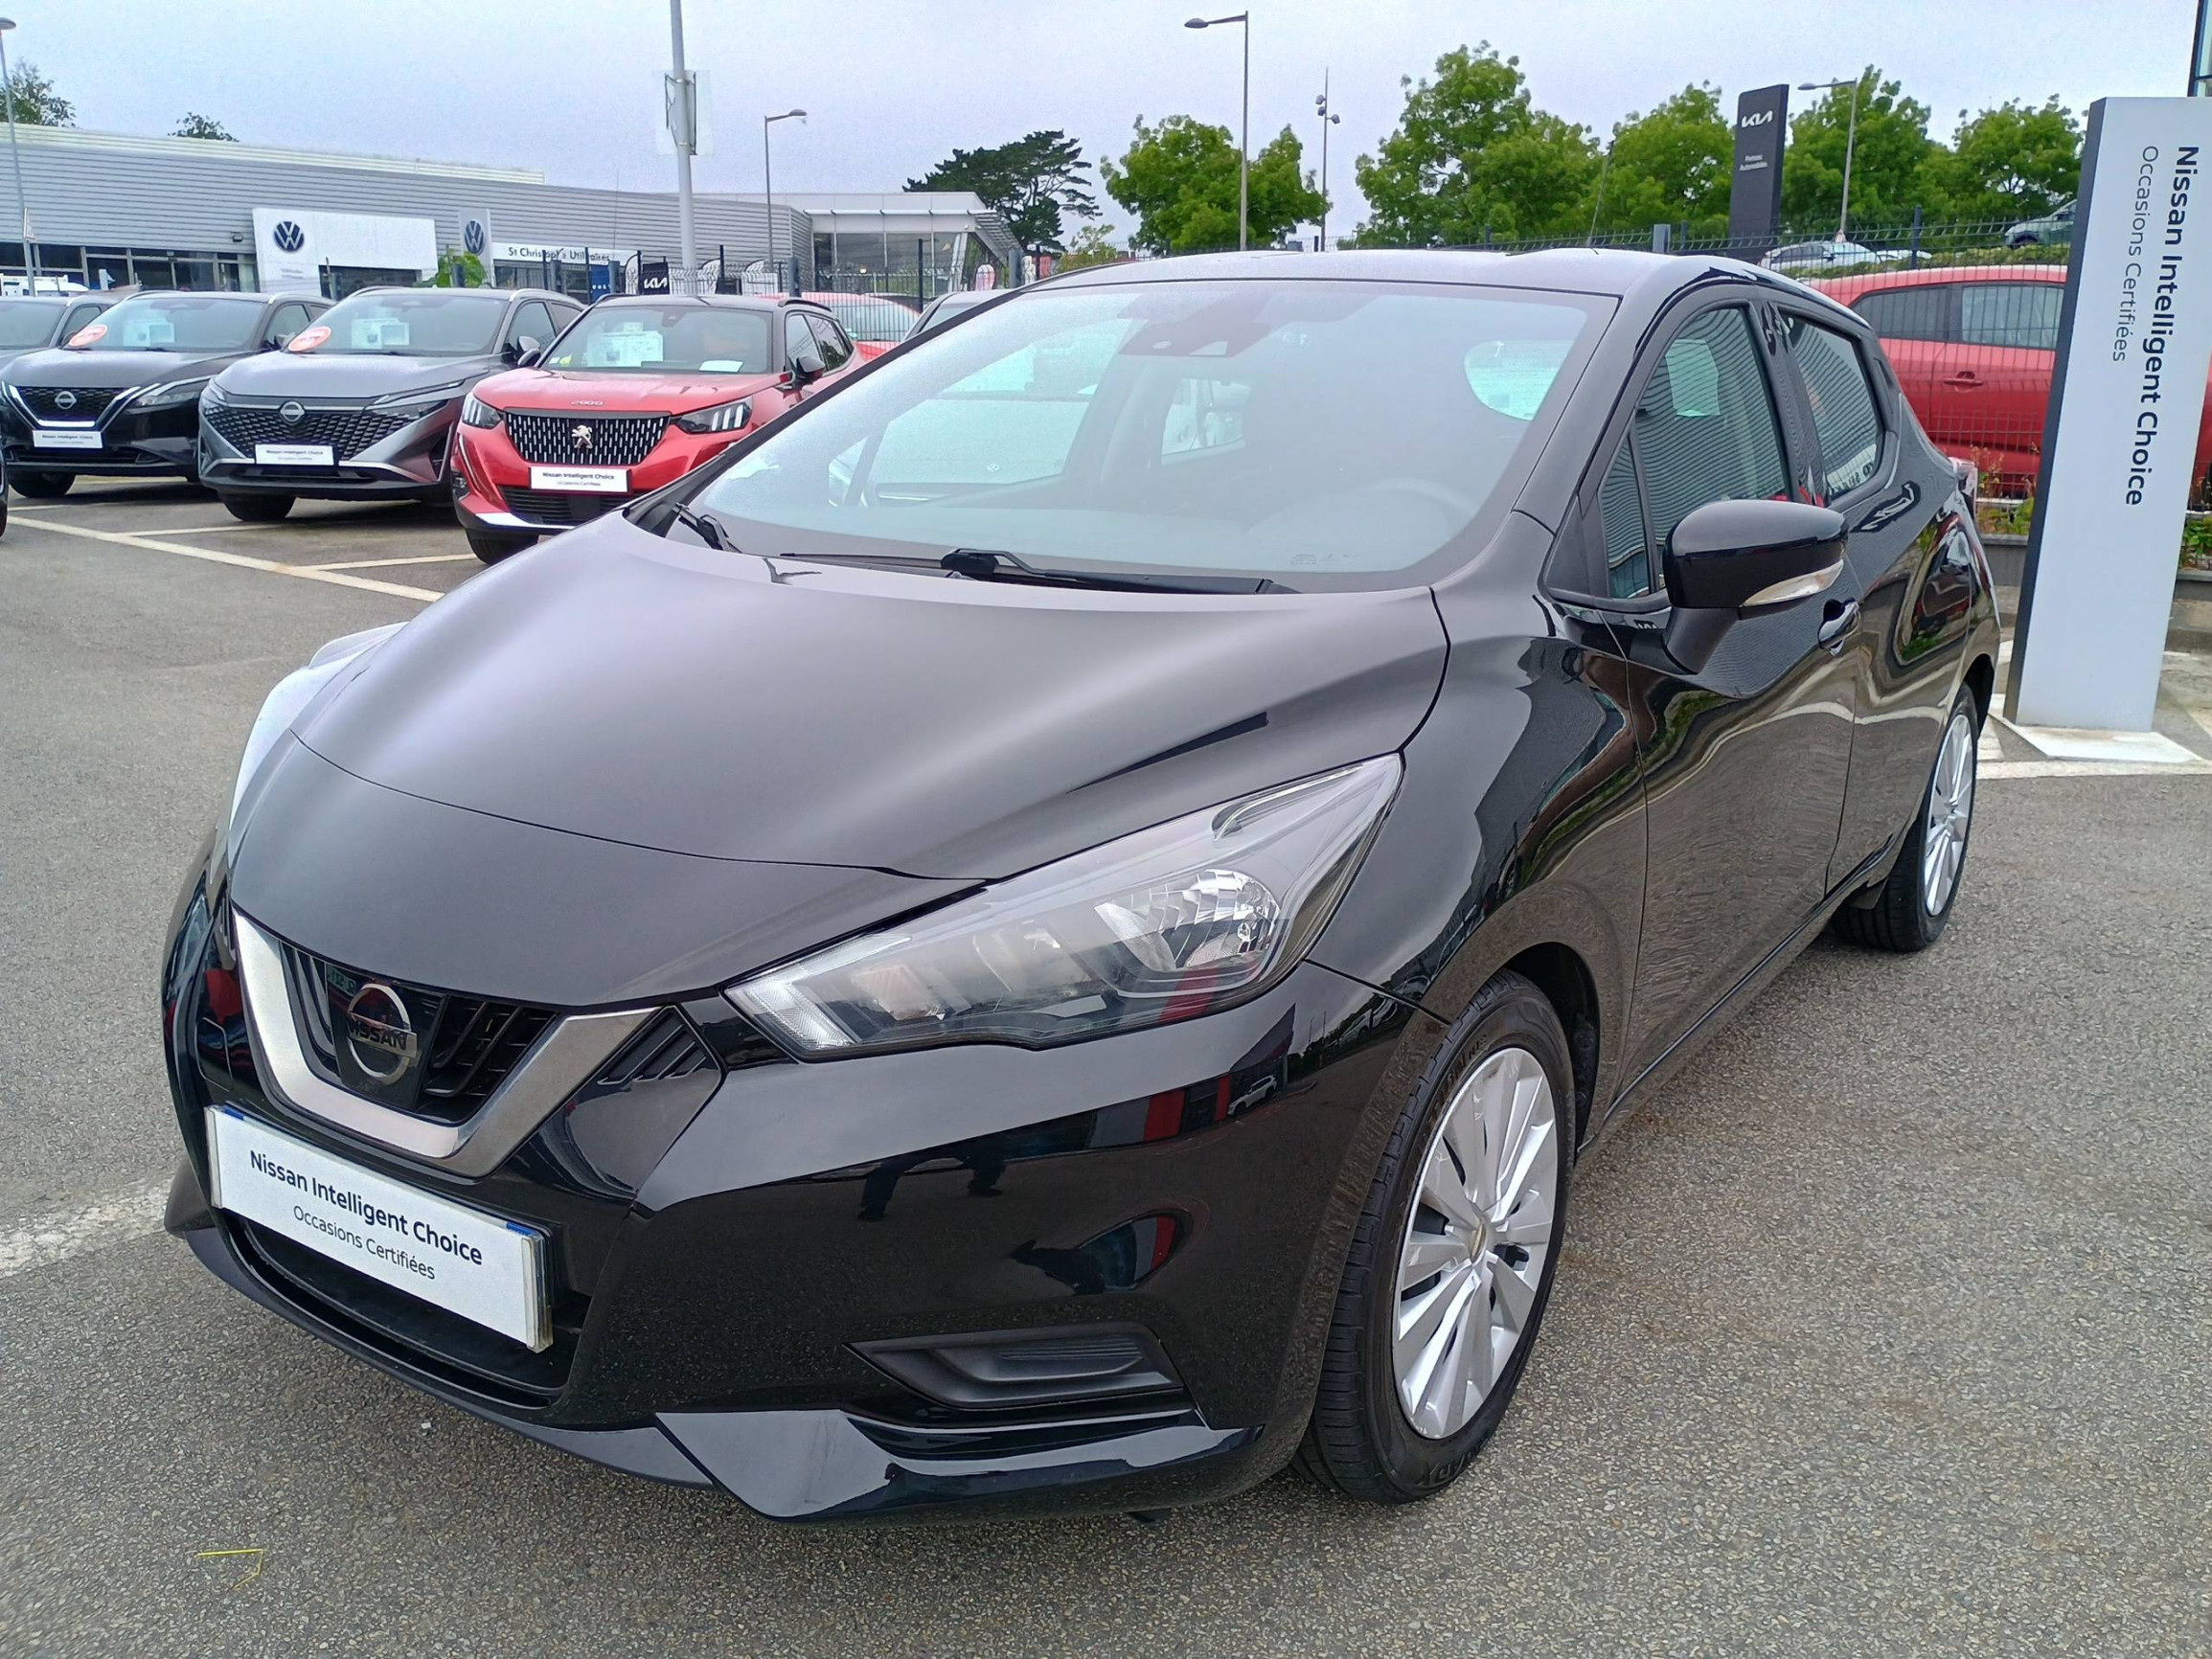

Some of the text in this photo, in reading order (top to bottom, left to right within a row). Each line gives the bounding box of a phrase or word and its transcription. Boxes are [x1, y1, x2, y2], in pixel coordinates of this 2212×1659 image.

[508, 247, 517, 257] St
[2112, 146, 2159, 361] Occasions Certifiées
[2126, 147, 2200, 505] Nissan Intelligent Choice
[349, 1015, 408, 1052] NISSAN
[250, 1149, 483, 1265] Nissan Intelligent Choice
[293, 1205, 436, 1280] Occasions Certifiées
